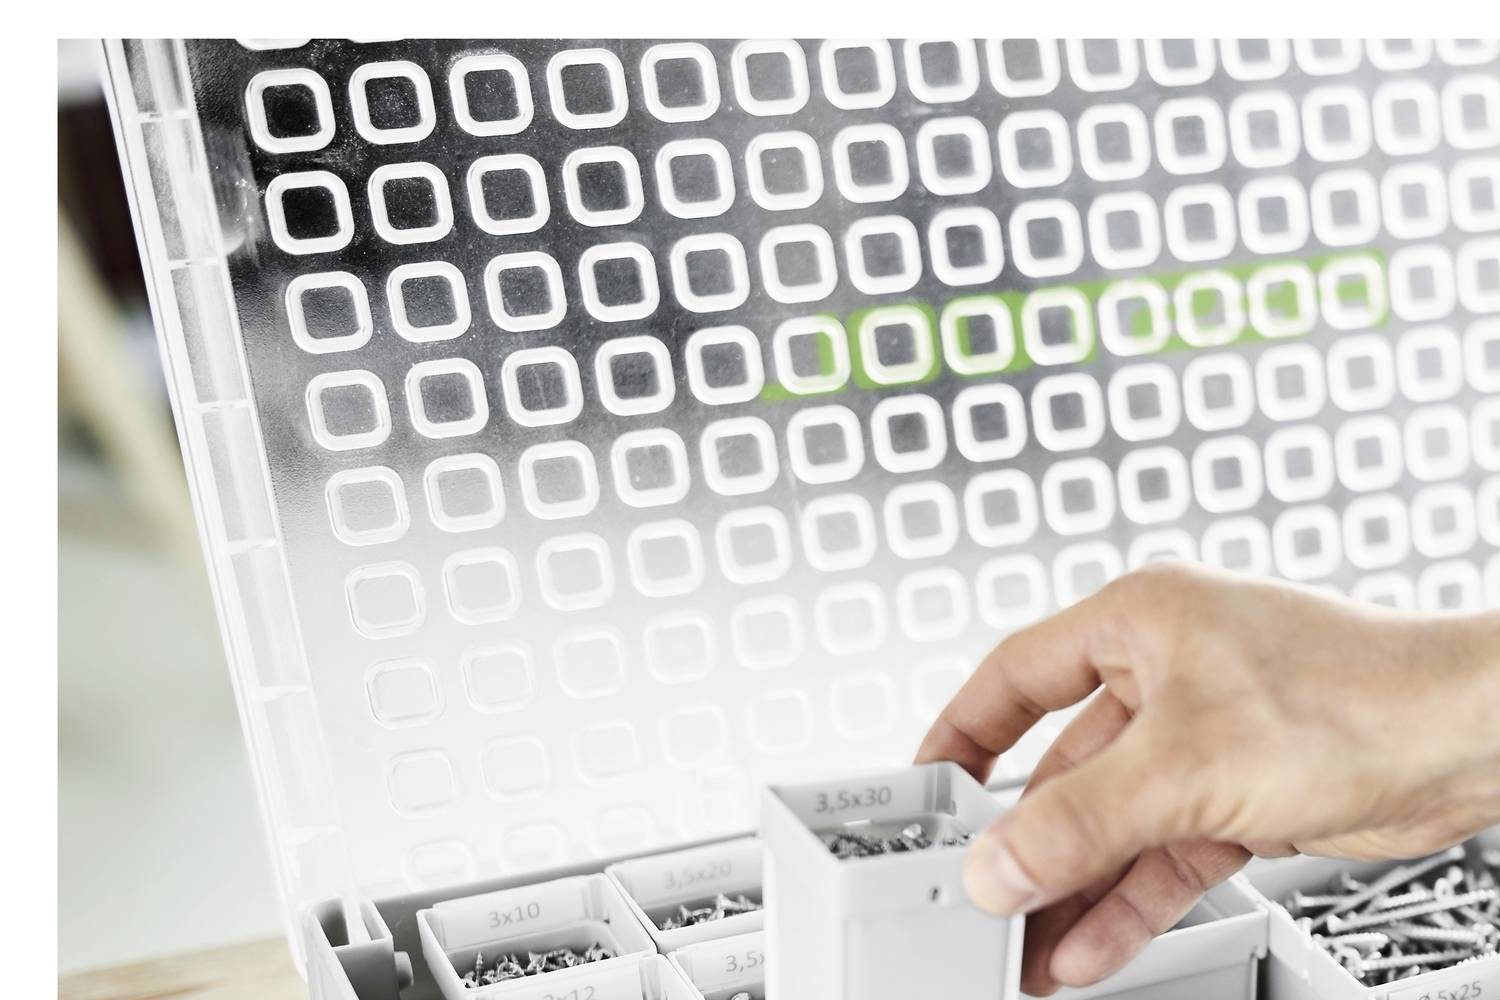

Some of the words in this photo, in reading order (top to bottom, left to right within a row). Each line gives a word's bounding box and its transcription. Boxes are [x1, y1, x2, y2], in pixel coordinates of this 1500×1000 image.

[814, 785, 893, 815] 3,5x30
[663, 858, 733, 891] 3,5x20
[487, 901, 541, 929] 3x10
